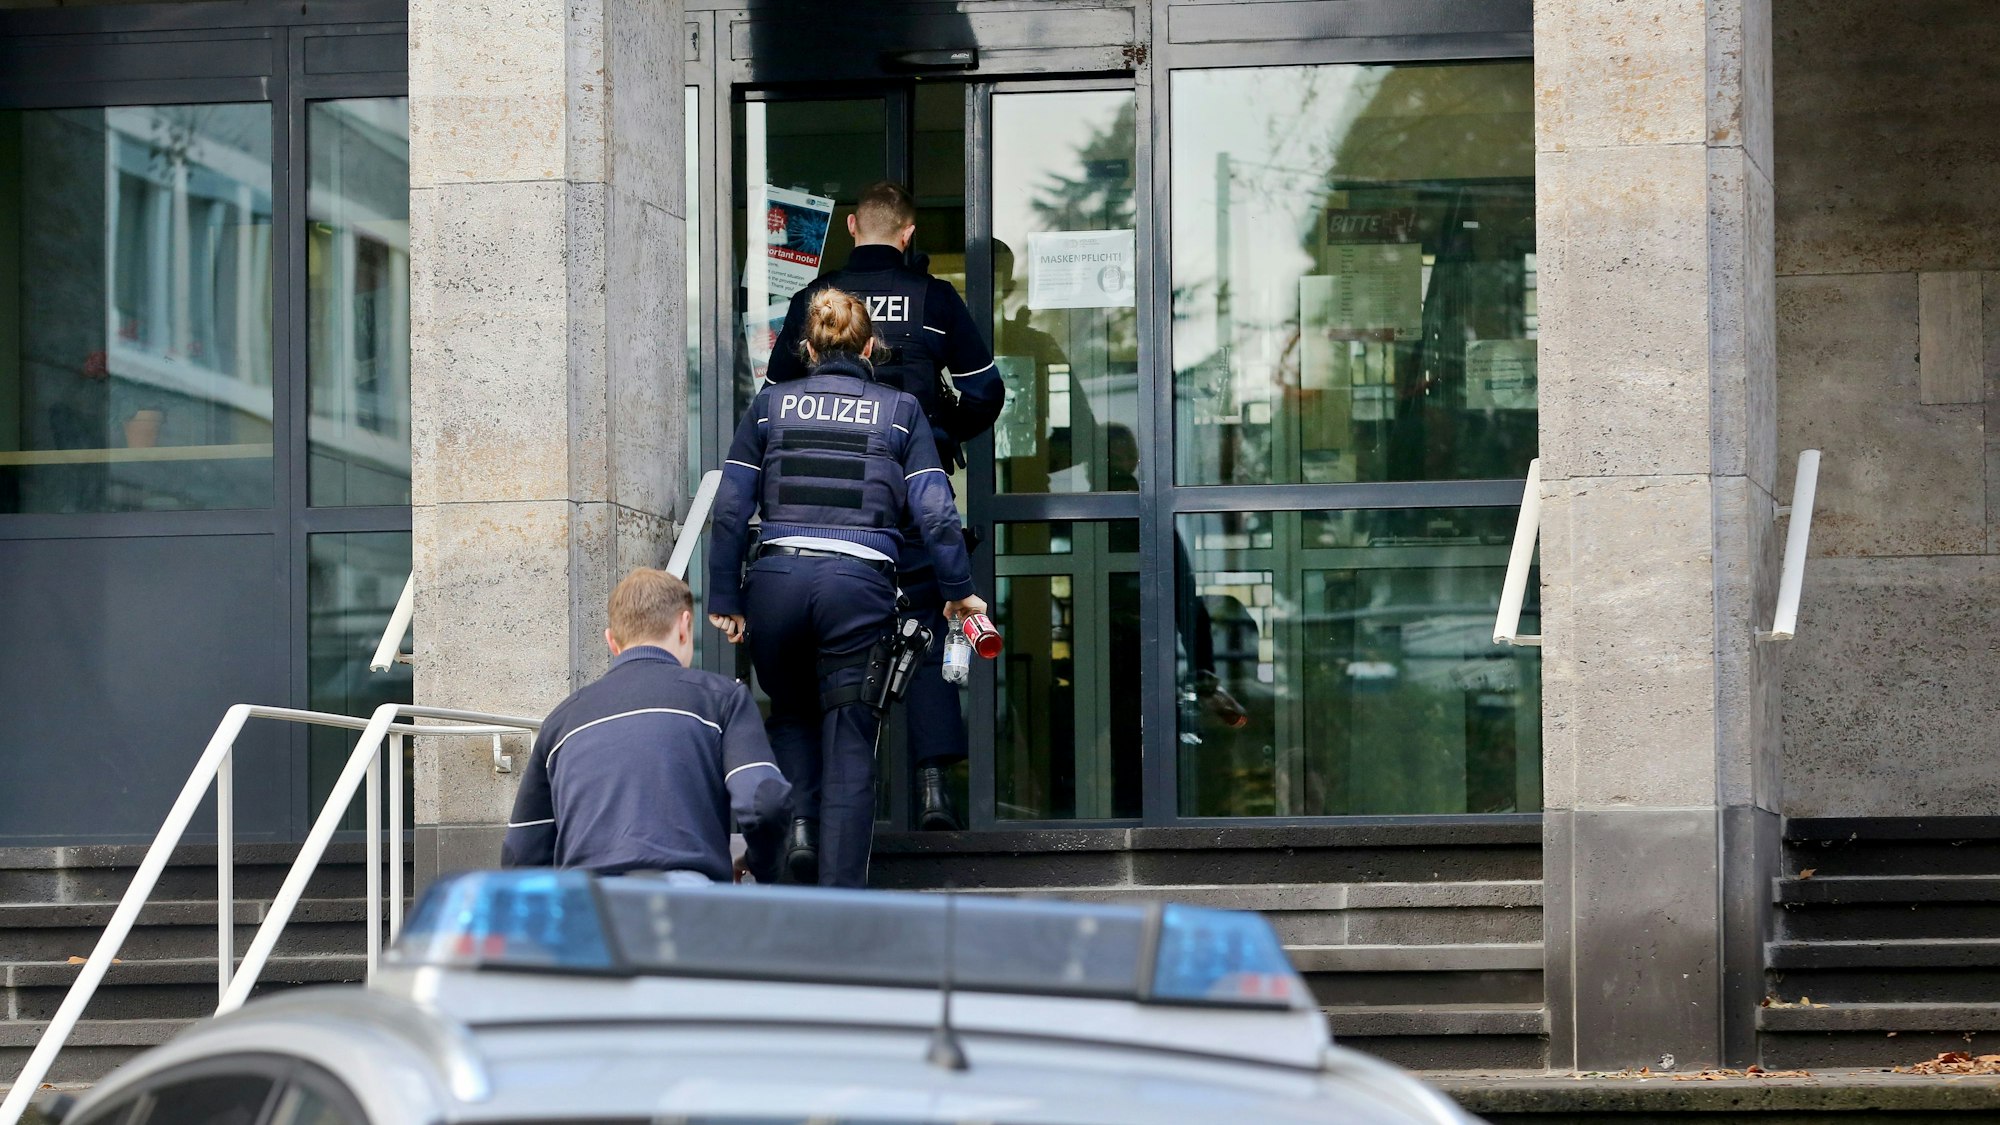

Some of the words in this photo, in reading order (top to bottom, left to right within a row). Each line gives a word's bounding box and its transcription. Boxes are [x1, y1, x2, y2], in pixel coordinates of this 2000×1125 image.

[768, 249, 794, 259] ortant
[796, 254, 817, 264] note!
[1040, 252, 1122, 264] MASKENPFLICHT!
[866, 296, 910, 322] IZEI
[780, 394, 880, 425] POLIZEI
